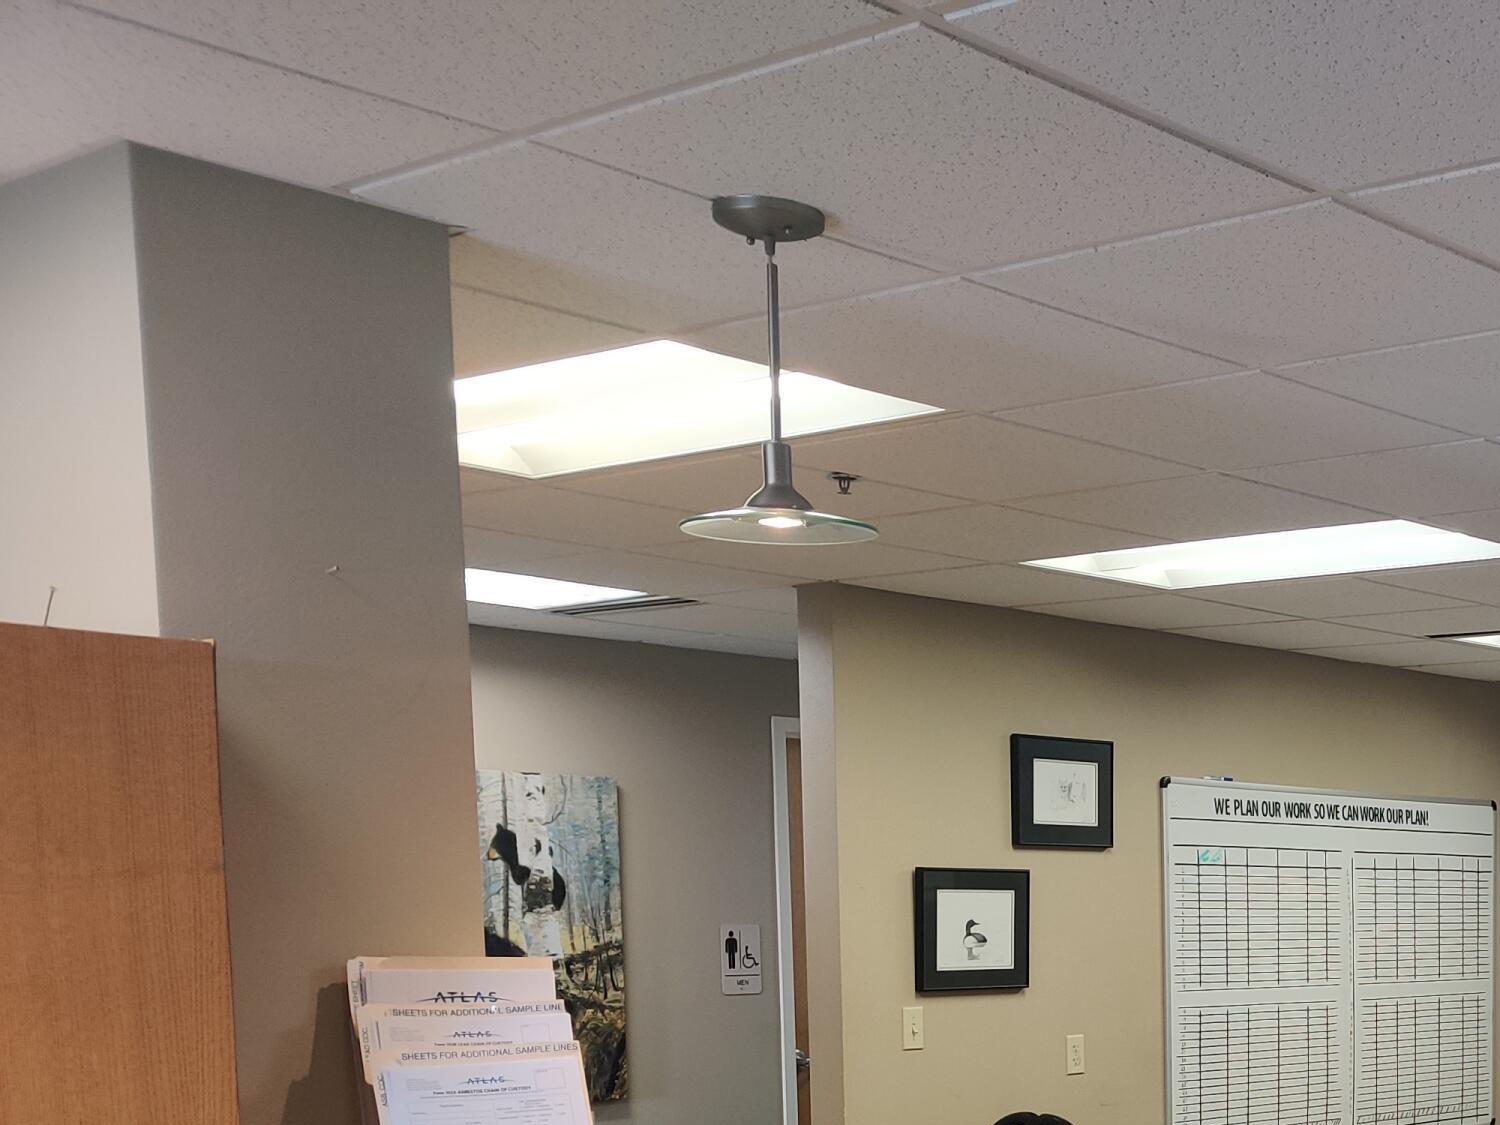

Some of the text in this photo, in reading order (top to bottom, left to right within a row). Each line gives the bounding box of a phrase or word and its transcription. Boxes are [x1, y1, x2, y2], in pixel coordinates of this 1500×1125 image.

[1213, 797, 1429, 826] WE PLAN OUR WORK SO WE CAN WORK OUR PLAN!
[434, 991, 498, 1003] ATLAS
[392, 1008, 427, 1017] SHEETS
[429, 1008, 448, 1016] FOR
[505, 1004, 542, 1014] SAMPLE
[401, 1041, 578, 1061] SHEETS FOR ADDITIONAL SAMPLE LINES
[467, 1076, 505, 1084] ATLAS
